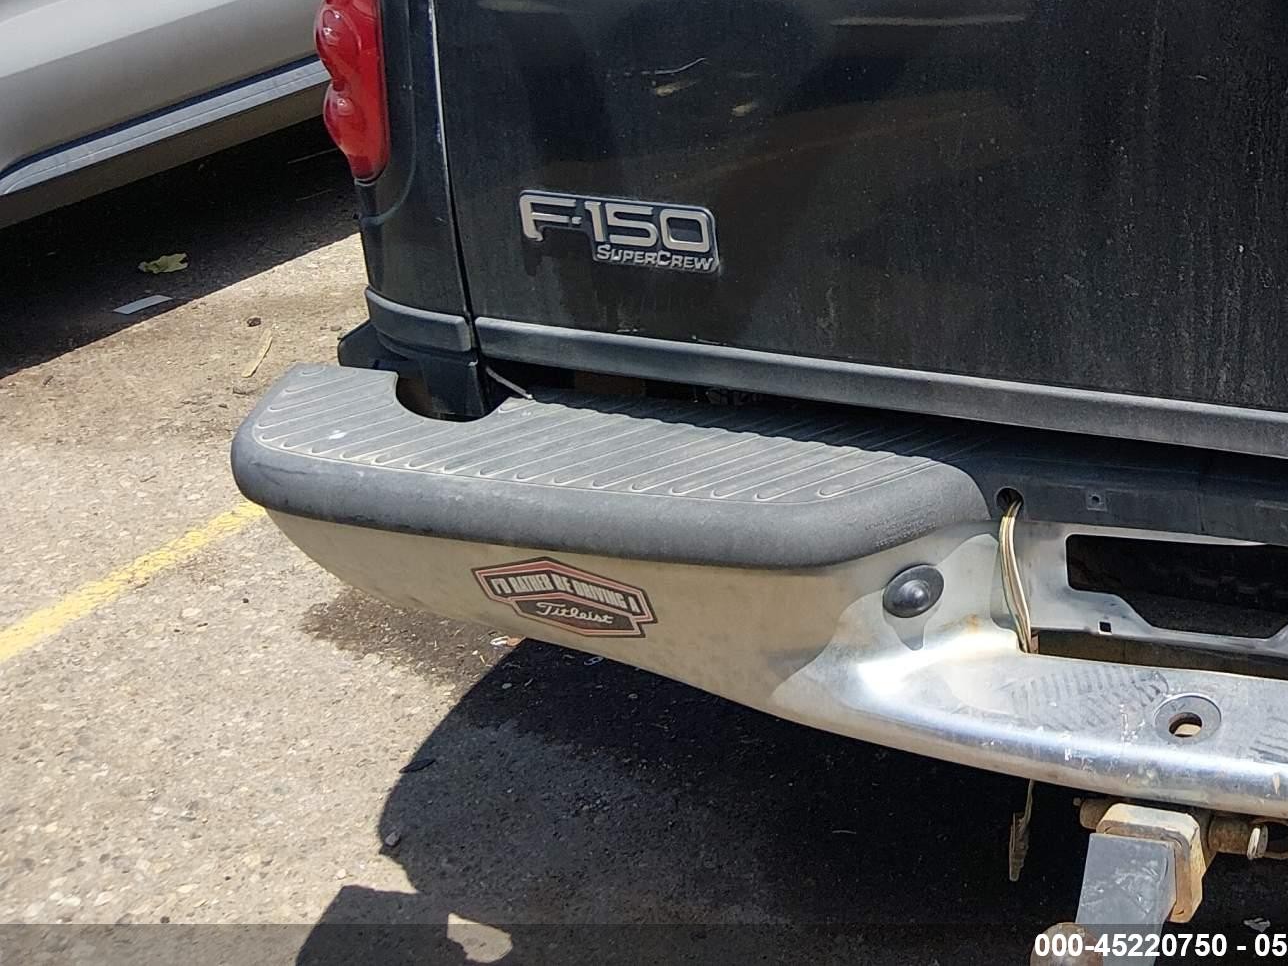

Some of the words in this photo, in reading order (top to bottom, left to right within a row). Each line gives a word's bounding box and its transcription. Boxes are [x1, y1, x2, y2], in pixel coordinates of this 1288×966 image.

[519, 193, 711, 253] F-150
[507, 573, 554, 594] RATHER
[550, 573, 575, 592] BE
[571, 579, 628, 610] DRIVING
[627, 595, 641, 613] A
[535, 601, 615, 624] Titleist
